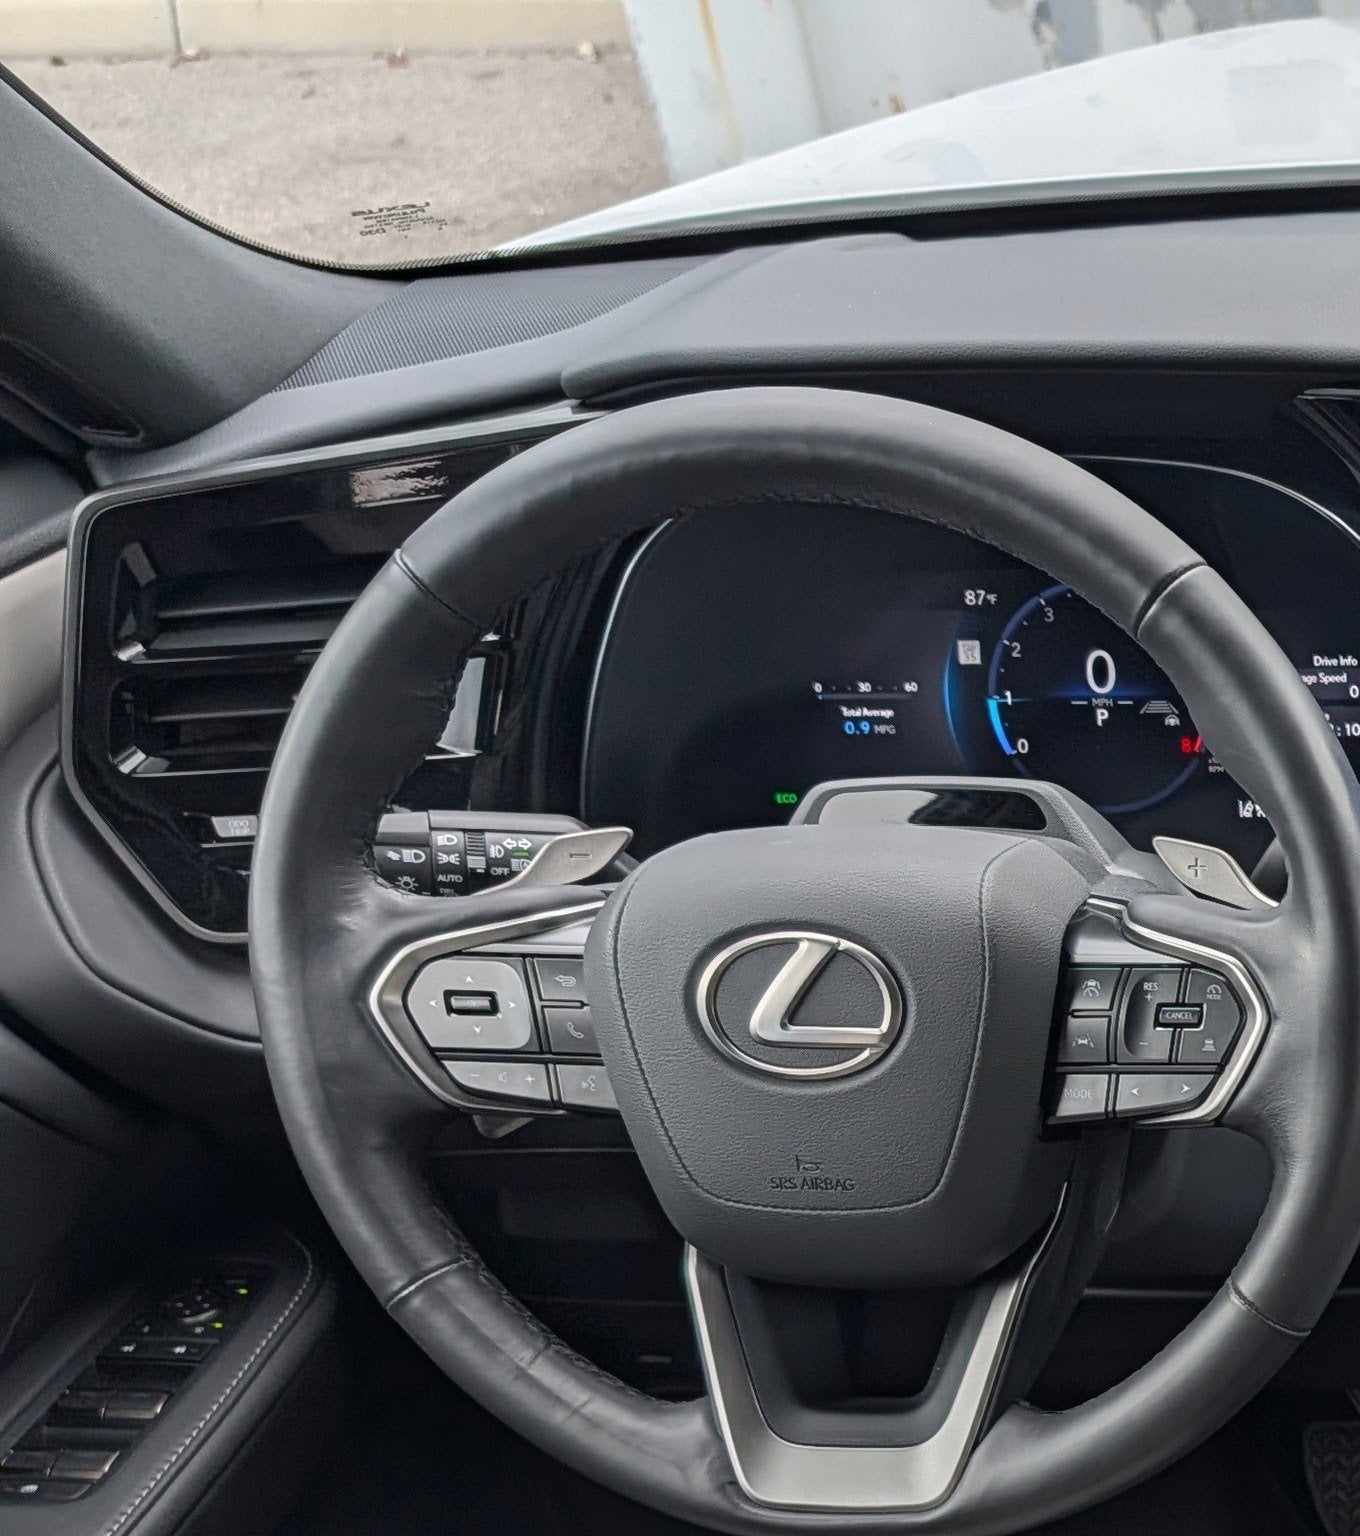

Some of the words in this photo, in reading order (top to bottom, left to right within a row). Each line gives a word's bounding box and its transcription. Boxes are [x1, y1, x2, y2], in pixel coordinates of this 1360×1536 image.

[1043, 607, 1055, 623] 3
[1010, 642, 1022, 658] 2
[1313, 655, 1338, 667] Drive
[1339, 655, 1359, 667] Info
[1318, 672, 1348, 685] Speed
[812, 681, 823, 693] 0
[857, 680, 872, 693] 30
[903, 680, 919, 693] 60
[1349, 684, 1360, 699] 0
[1004, 690, 1013, 705] 1
[1096, 708, 1109, 727] P
[843, 720, 871, 735] 0.9
[1016, 738, 1029, 754] 0
[490, 866, 511, 876] OFF
[437, 873, 463, 883] AUTO
[1142, 981, 1159, 991] RES
[1166, 1011, 1194, 1020] CANCEL
[1063, 1089, 1093, 1100] MODE
[800, 1177, 855, 1191] AIRBAG
